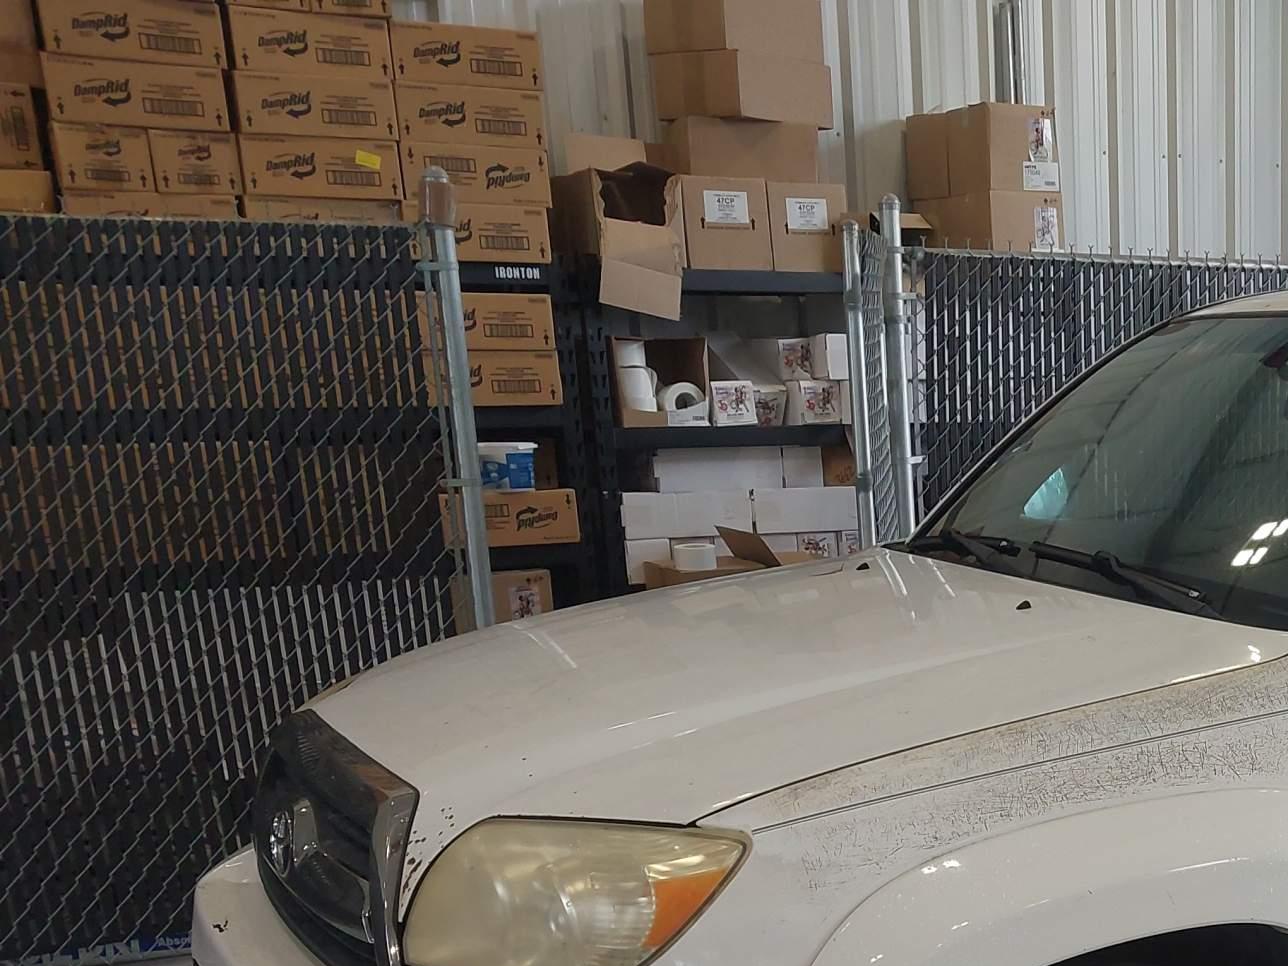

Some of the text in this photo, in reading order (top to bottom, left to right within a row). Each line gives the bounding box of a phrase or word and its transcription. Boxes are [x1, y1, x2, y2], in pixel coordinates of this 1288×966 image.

[72, 13, 128, 31] DampRid
[258, 30, 307, 48] DampRid
[414, 41, 460, 58] DampRid
[74, 79, 129, 97] DampRid
[261, 91, 311, 109] DampRid
[419, 101, 464, 119] DampRid
[266, 152, 315, 171] DampRid
[486, 172, 530, 190] DampRid
[494, 266, 540, 279] IRONTON
[516, 511, 558, 531] DampRid
